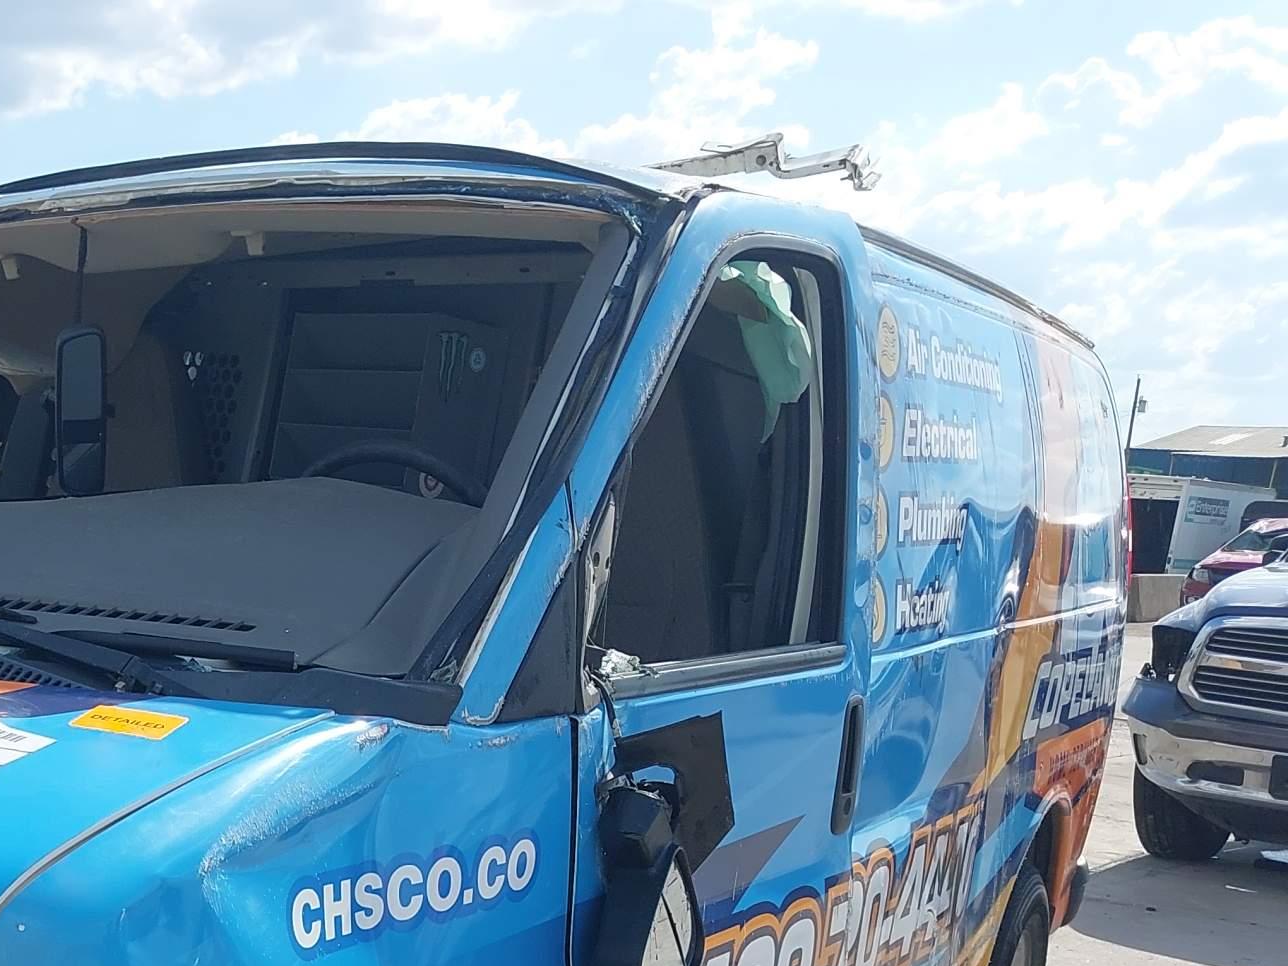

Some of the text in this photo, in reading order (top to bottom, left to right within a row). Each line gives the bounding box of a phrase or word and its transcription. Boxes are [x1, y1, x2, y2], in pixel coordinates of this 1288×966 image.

[906, 327, 1003, 403] Air Conditioning
[902, 407, 978, 460] Electrical
[898, 495, 968, 551] Plumbing
[90, 713, 166, 730] DETAILED
[291, 838, 537, 949] CHSCO.CO
